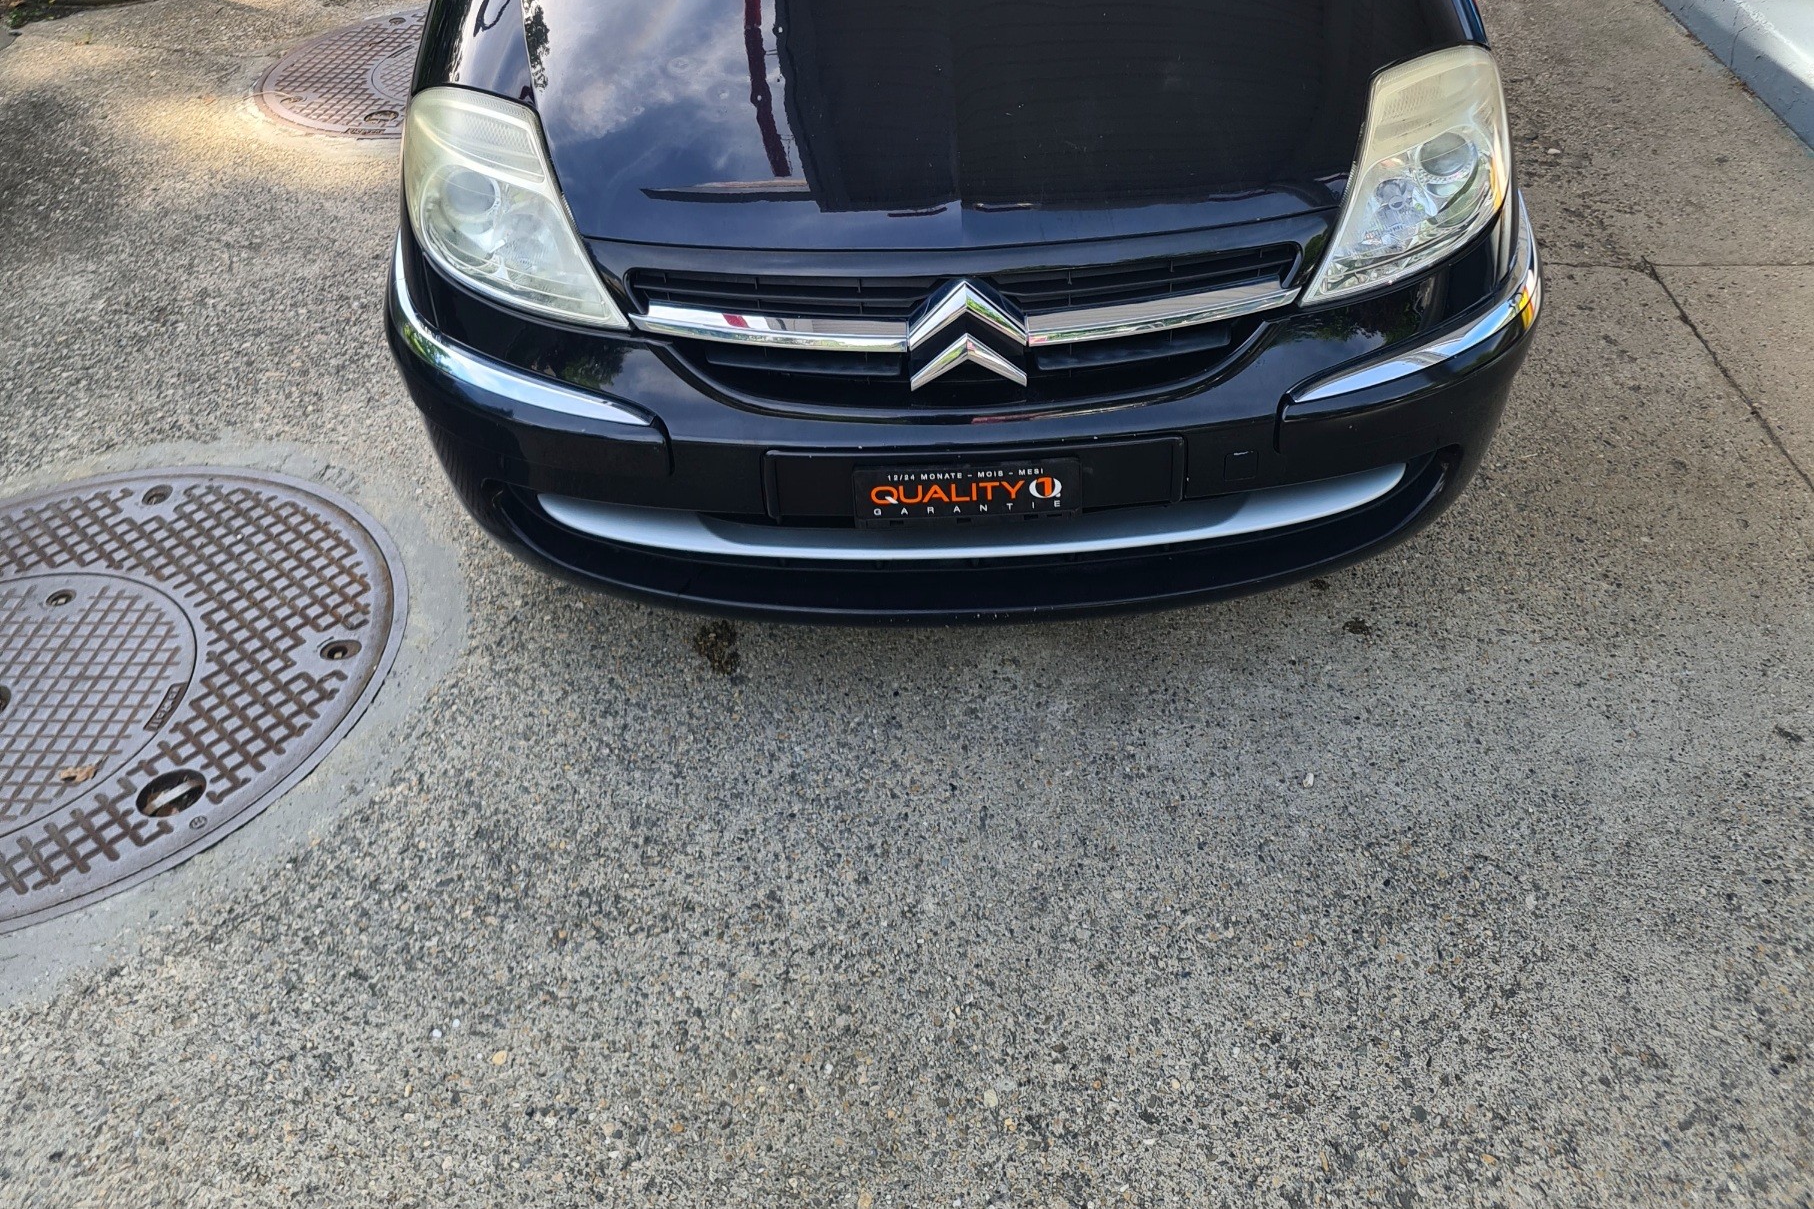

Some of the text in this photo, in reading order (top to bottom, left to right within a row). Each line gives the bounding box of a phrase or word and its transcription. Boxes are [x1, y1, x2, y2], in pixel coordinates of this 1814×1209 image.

[887, 473, 916, 482] 12/24
[920, 471, 963, 481] MONATE
[977, 470, 1004, 478] MOIS
[1018, 467, 1044, 476] MESI
[871, 480, 1025, 504] QUALITY
[873, 500, 1061, 516] GARANTIE
